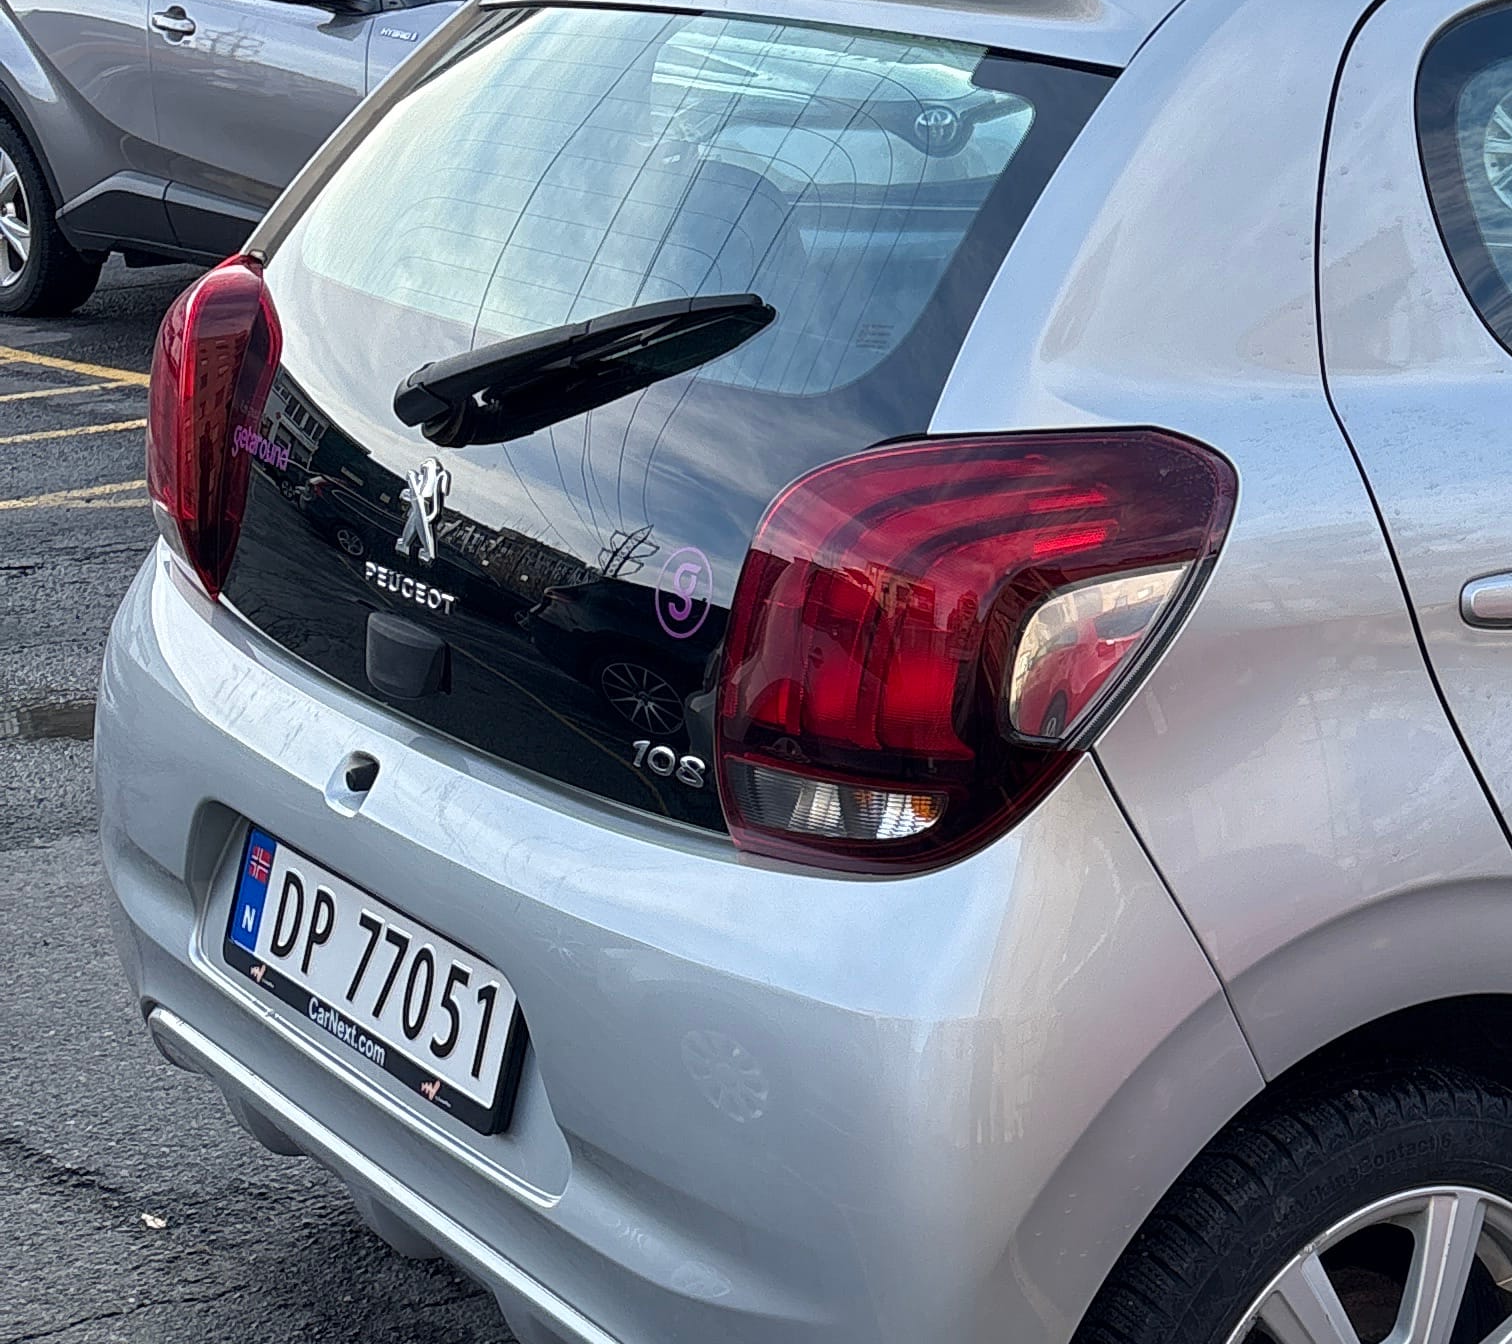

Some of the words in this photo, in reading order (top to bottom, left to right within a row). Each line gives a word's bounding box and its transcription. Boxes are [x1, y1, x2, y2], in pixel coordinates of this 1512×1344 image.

[232, 424, 291, 471] getaround
[364, 561, 455, 615] PEUGEOT
[631, 740, 706, 788] 108
[241, 904, 256, 933] N
[270, 867, 336, 975] DP
[346, 908, 499, 1080] 77051
[308, 996, 386, 1066] CarNext.com
